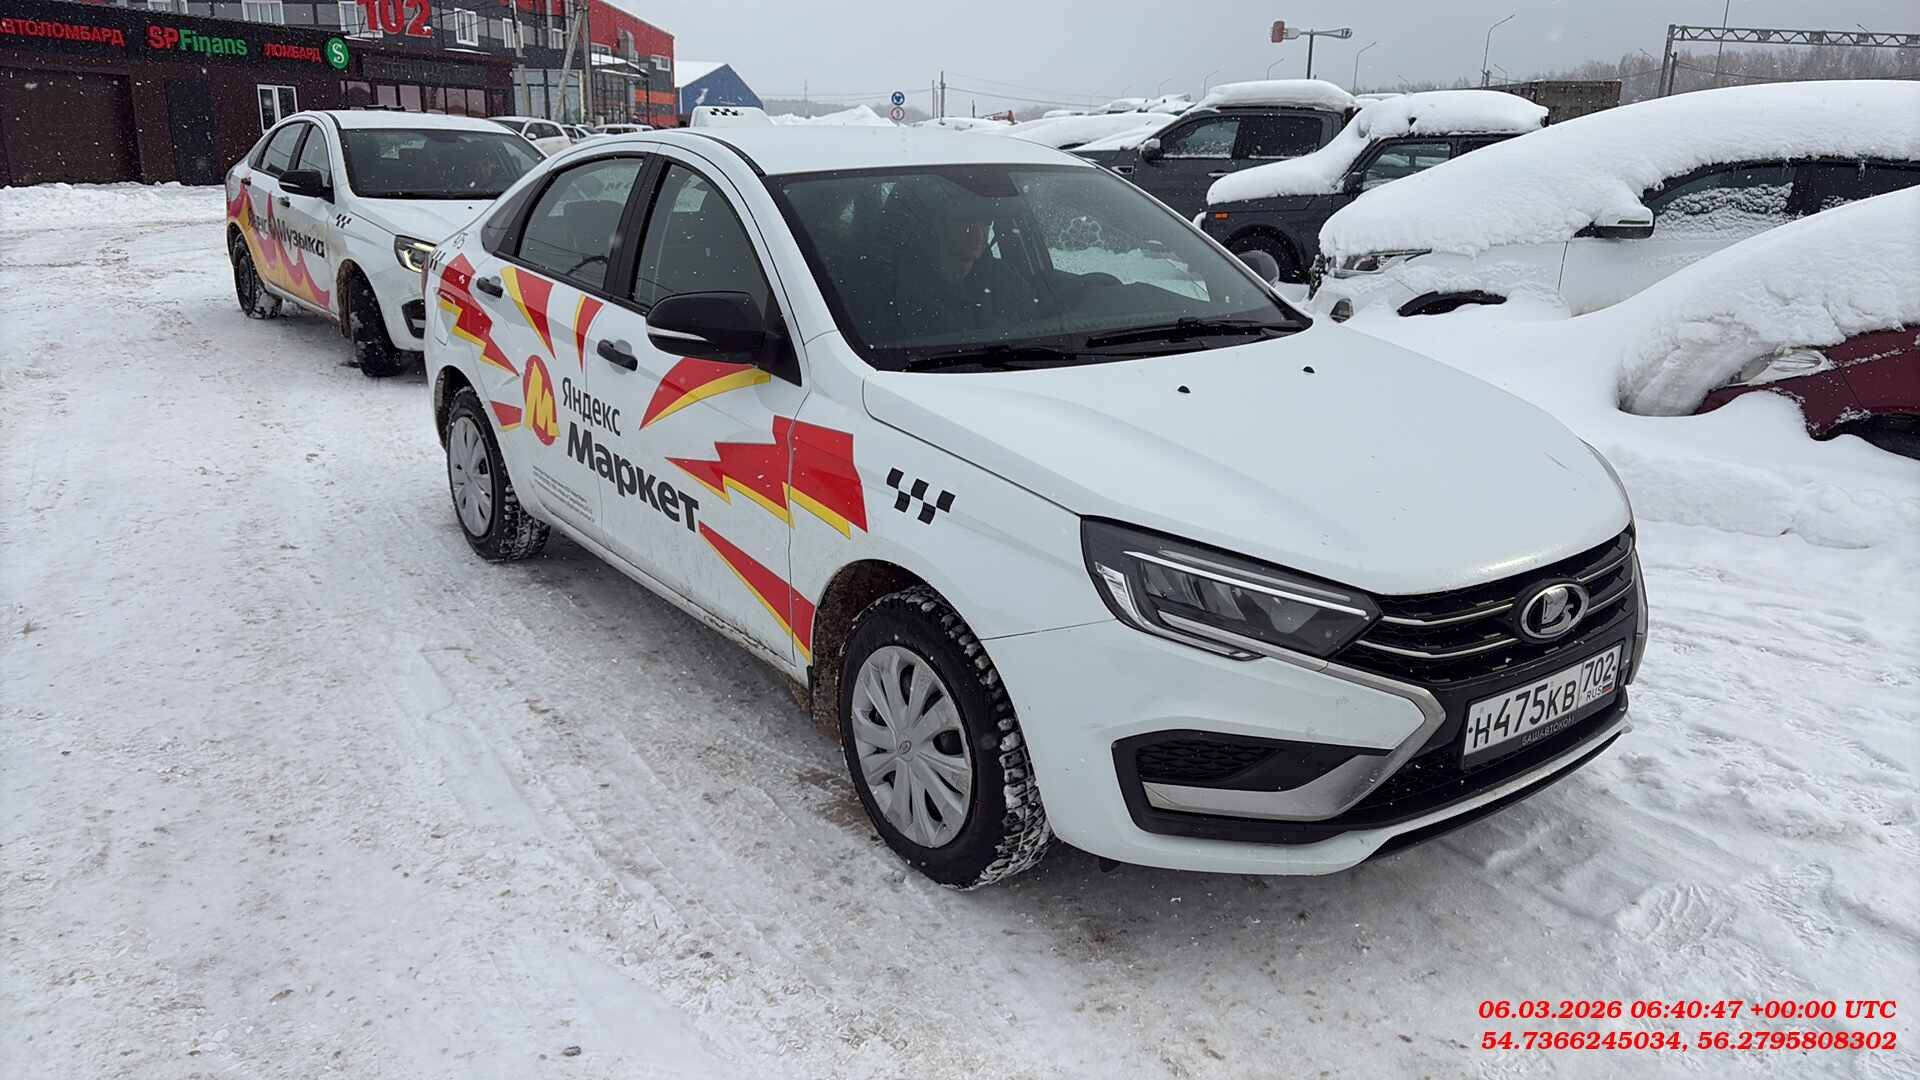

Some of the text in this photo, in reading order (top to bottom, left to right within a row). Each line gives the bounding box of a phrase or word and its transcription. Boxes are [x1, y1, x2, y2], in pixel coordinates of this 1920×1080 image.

[357, 0, 433, 38] 102
[147, 25, 248, 56] SPFinans
[264, 43, 322, 63] ЛОМБАРД
[562, 376, 622, 437] Яндекс
[566, 421, 700, 533] Маркет
[1583, 651, 1615, 693] 702
[1586, 685, 1603, 700] RUS
